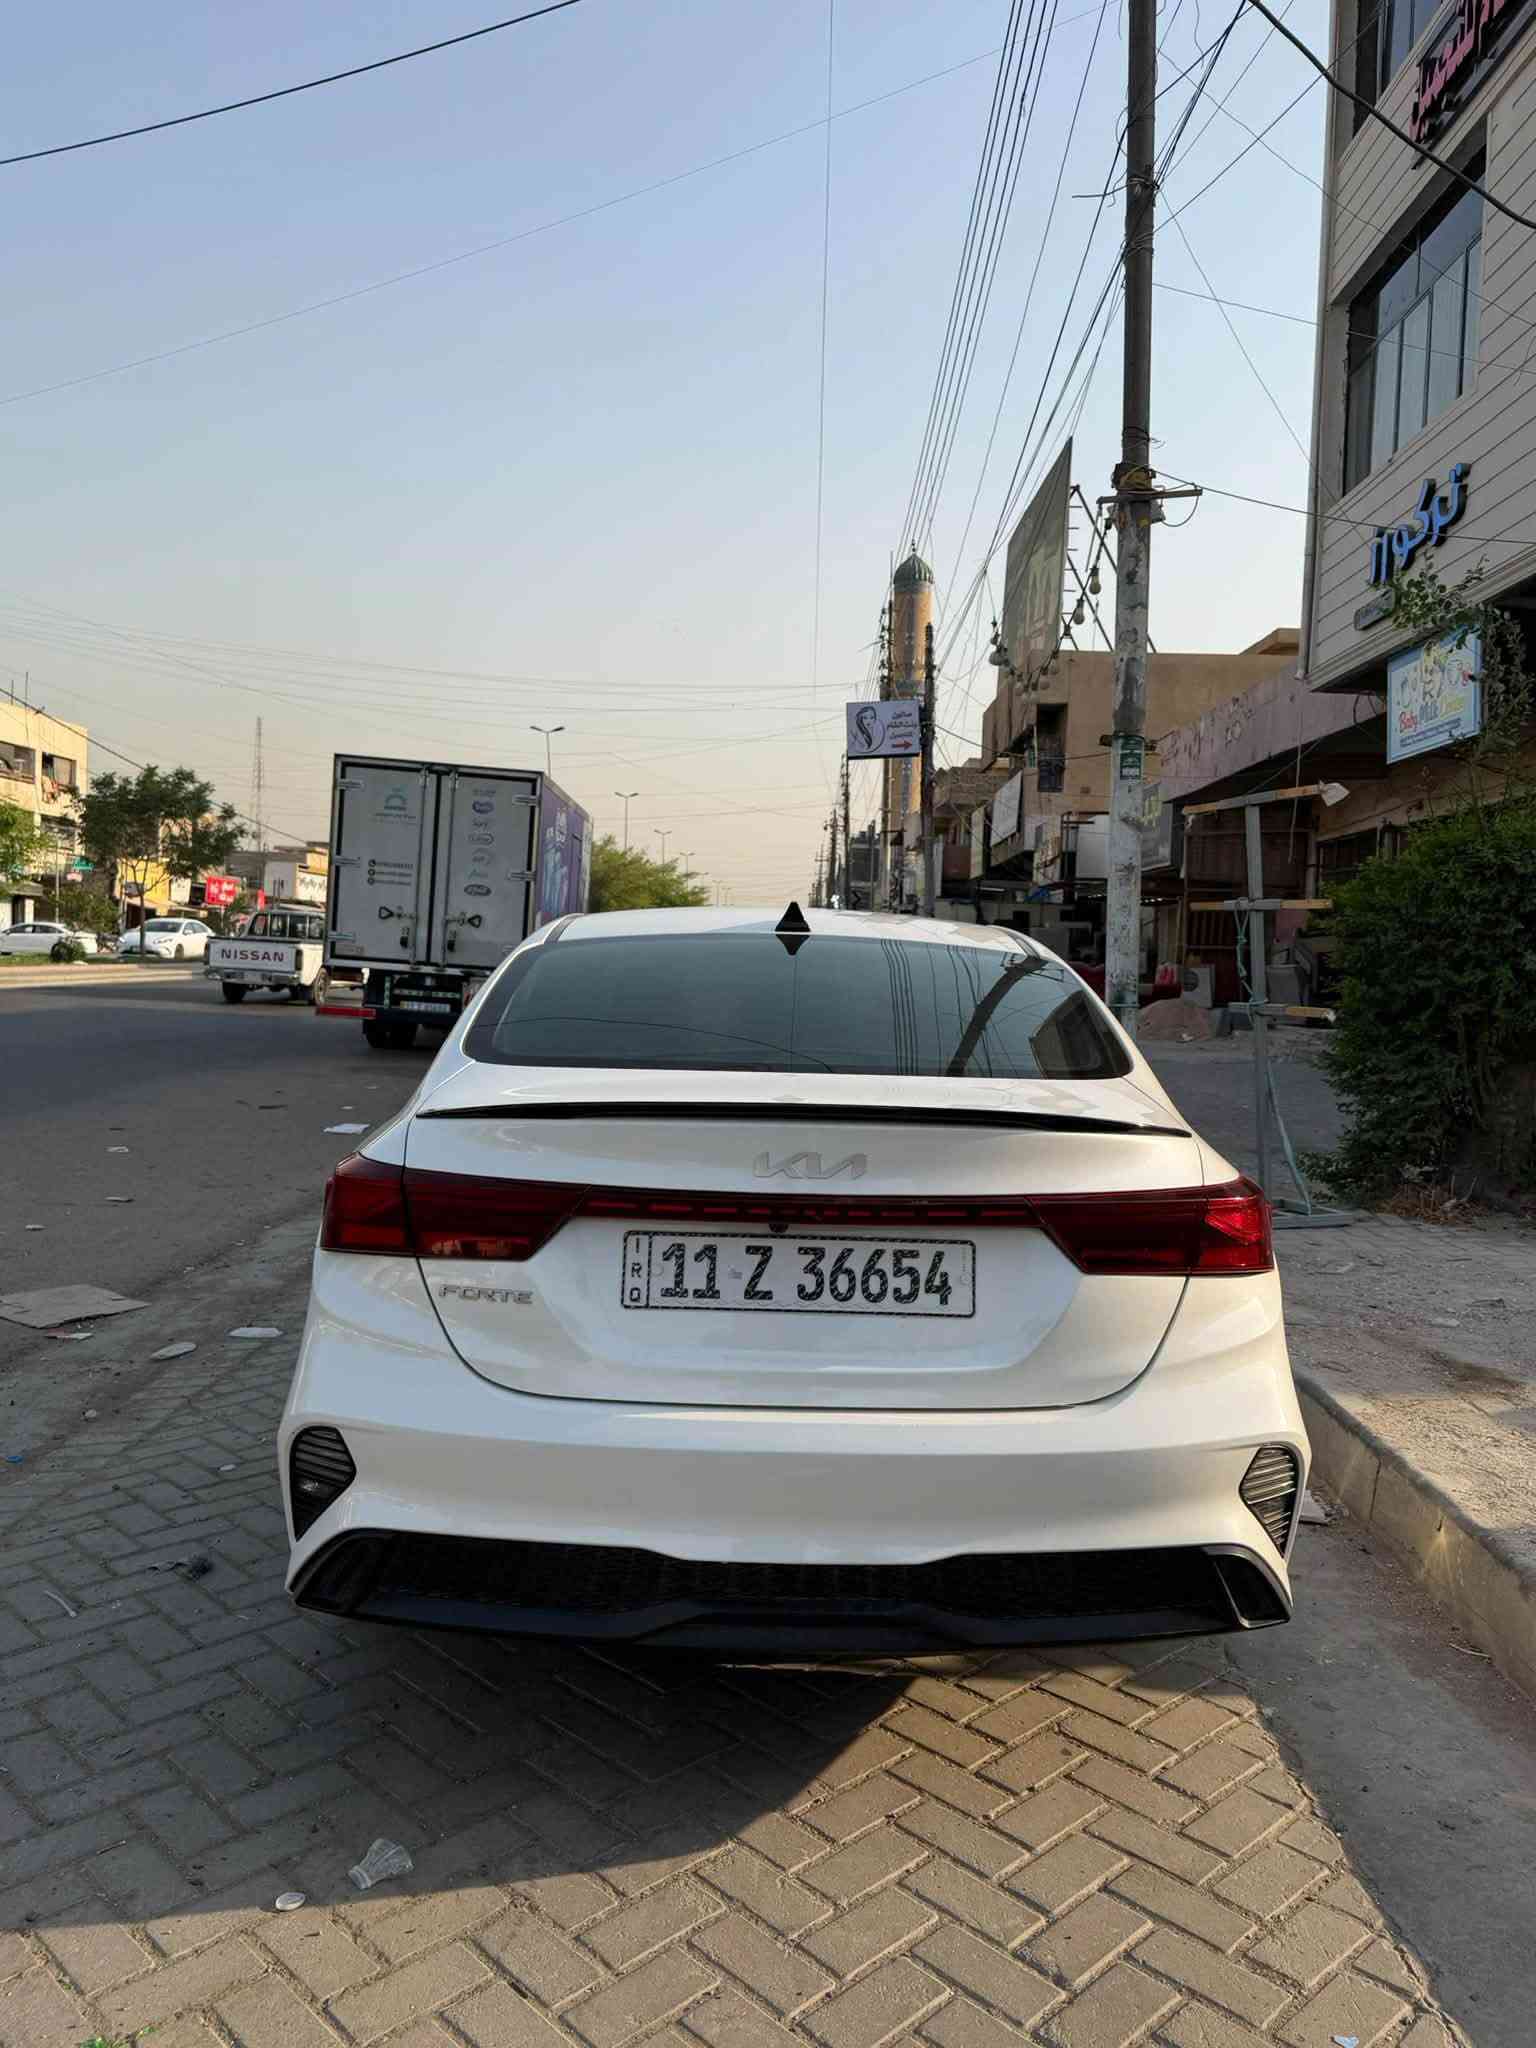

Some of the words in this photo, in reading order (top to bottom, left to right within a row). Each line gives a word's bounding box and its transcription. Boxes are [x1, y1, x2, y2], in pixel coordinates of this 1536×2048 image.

[221, 948, 284, 962] NISSAN
[753, 1152, 867, 1180] KIA
[660, 1243, 721, 1299] 11
[743, 1245, 774, 1301] Z
[797, 1246, 952, 1306] 36654
[439, 1284, 533, 1304] FORTE
